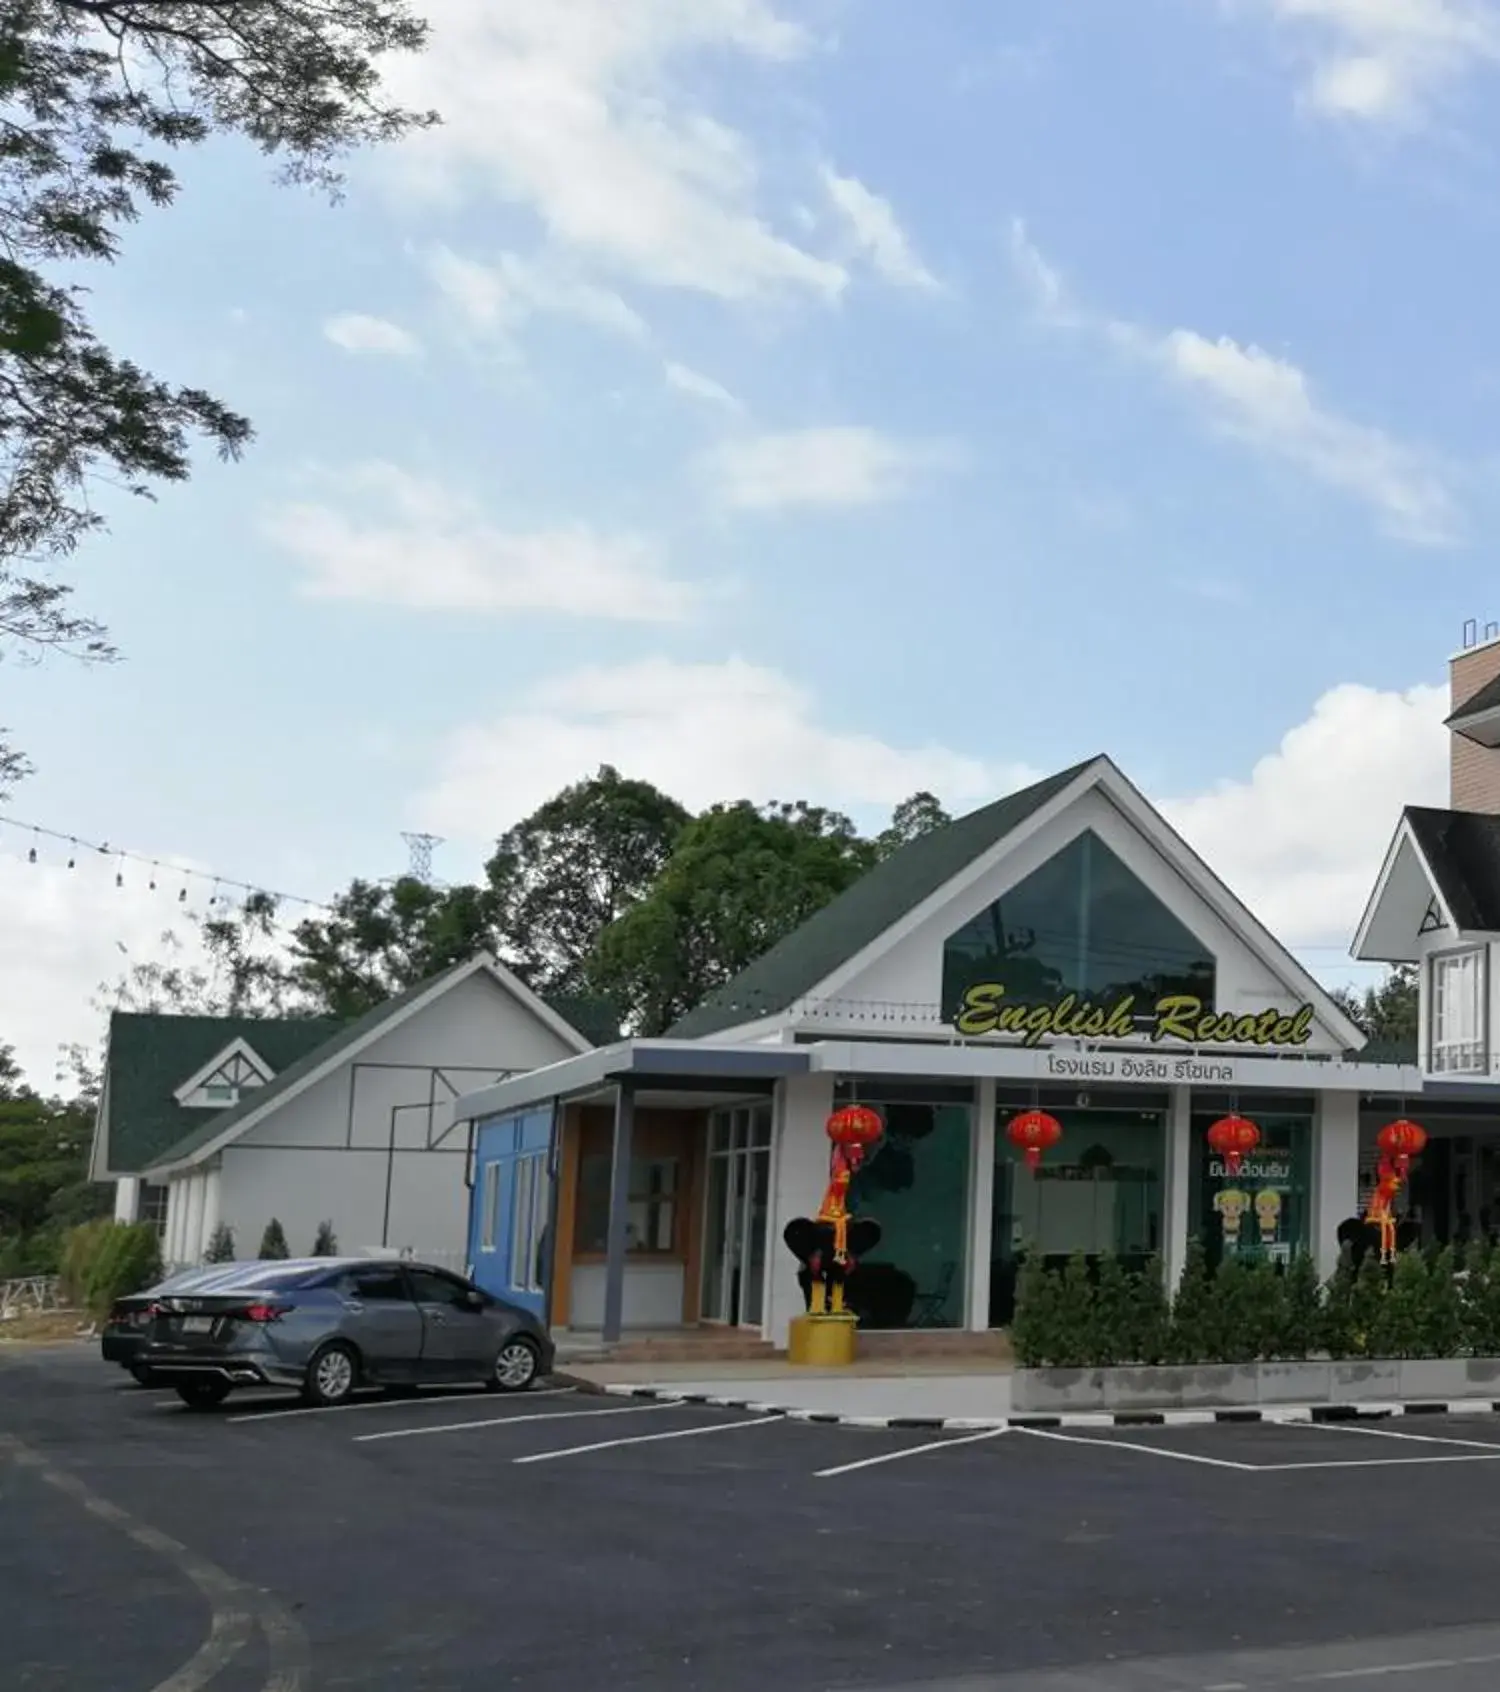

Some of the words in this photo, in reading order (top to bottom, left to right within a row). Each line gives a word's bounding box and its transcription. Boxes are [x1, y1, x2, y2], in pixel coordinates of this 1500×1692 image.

[955, 982, 1135, 1047] English
[1148, 994, 1314, 1045] Resotel
[1048, 1054, 1115, 1076] โรงแรม
